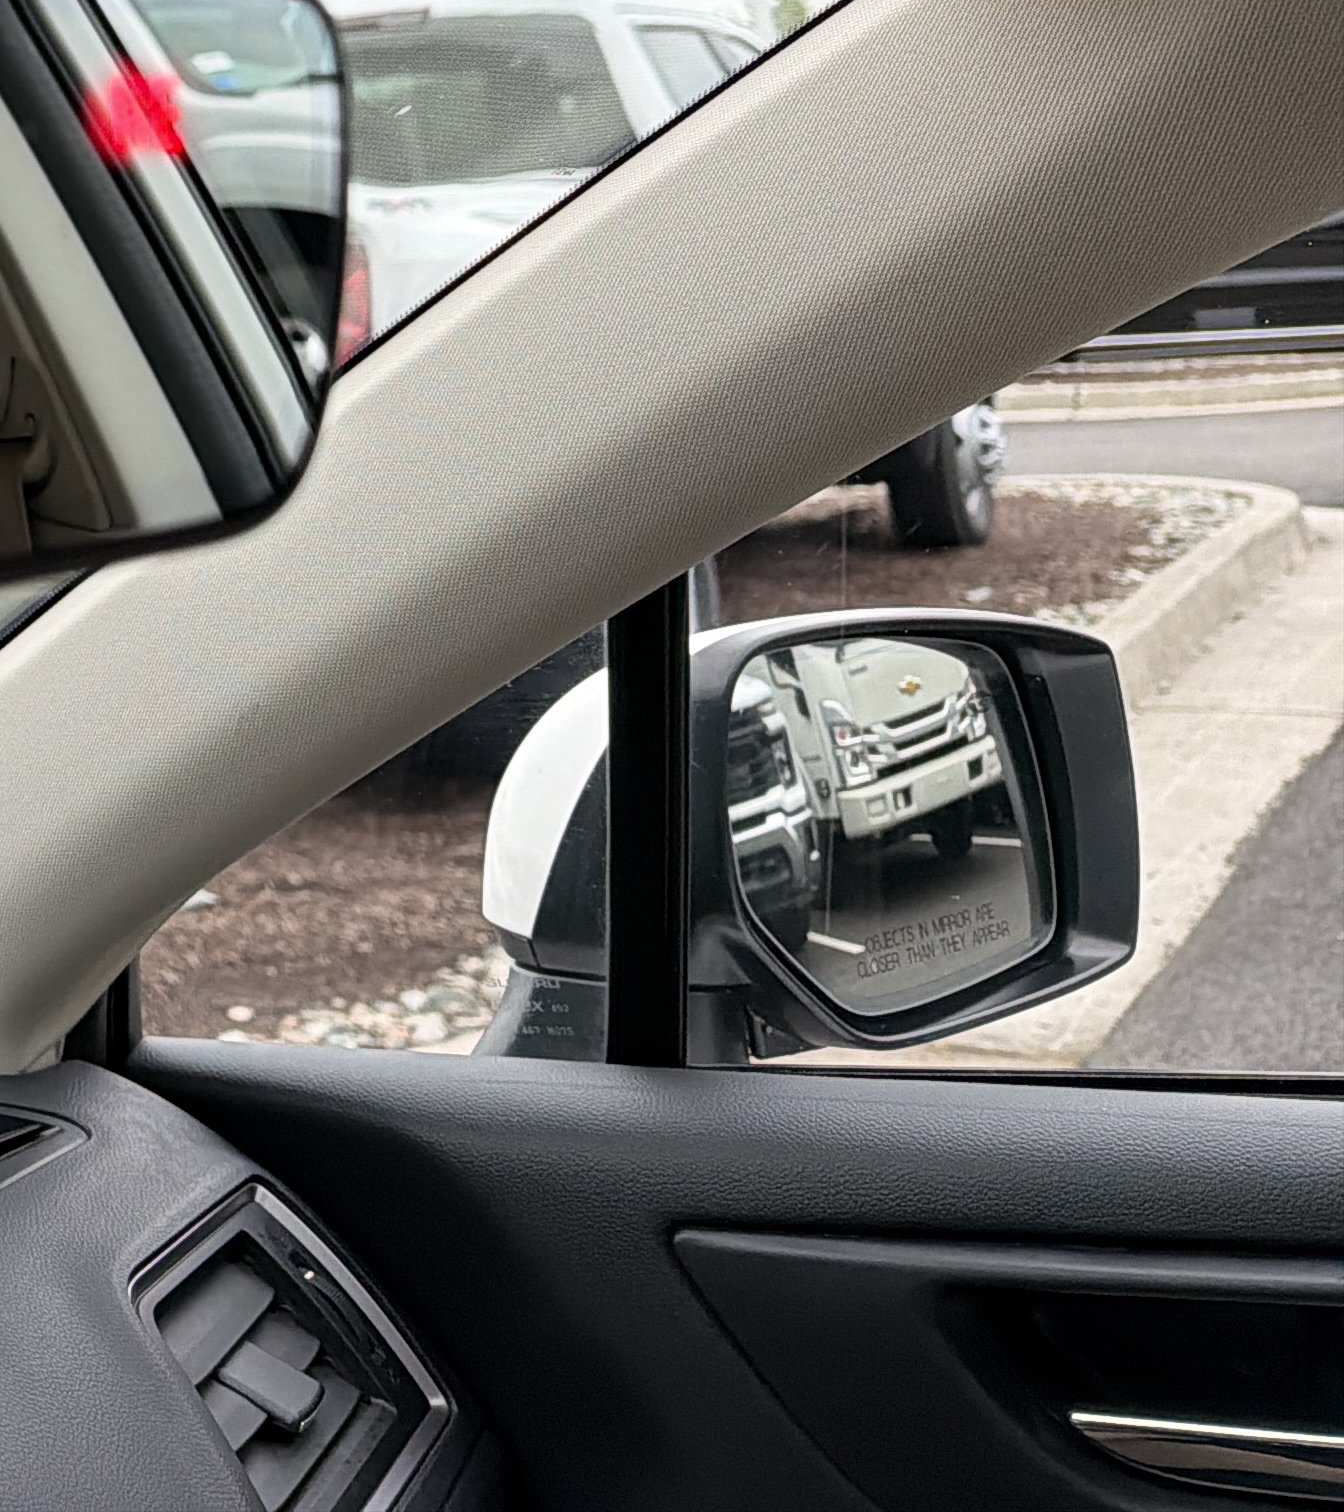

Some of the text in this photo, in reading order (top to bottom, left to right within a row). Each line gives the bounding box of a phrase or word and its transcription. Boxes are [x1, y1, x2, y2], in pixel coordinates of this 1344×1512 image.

[857, 920, 1010, 978] CLOSER THAN THEY APPEAR
[865, 925, 916, 953] OBJECTS
[975, 902, 995, 922] ARE
